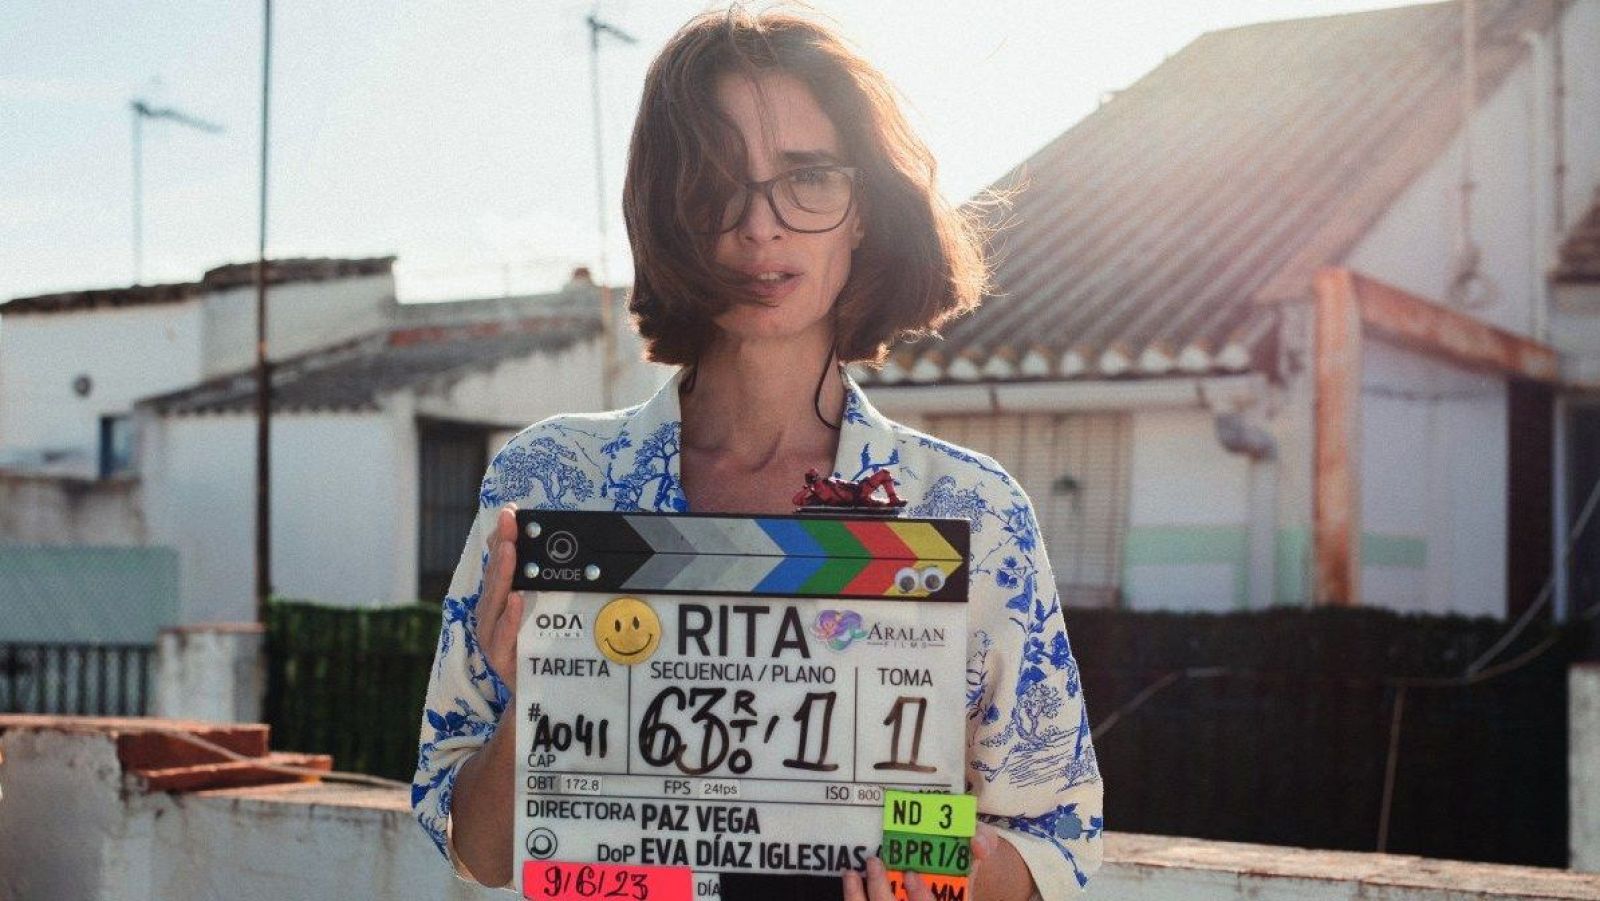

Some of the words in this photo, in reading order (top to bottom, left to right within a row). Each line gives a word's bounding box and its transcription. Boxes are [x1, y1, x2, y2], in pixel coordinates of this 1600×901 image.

[542, 568, 581, 581] OVIDE
[678, 604, 811, 658] RITA
[529, 657, 611, 678] TARJETA
[772, 665, 836, 684] PLANO
[878, 668, 933, 686] TOMA
[873, 696, 937, 773] 1
[527, 754, 556, 768] CAP
[527, 776, 556, 790] OBT
[566, 778, 599, 791] 172.8
[664, 780, 691, 795] FPS
[704, 783, 738, 795] 24fps
[826, 786, 849, 800] ISO
[858, 789, 881, 801] 800
[526, 800, 636, 821] DIRECTORA
[641, 804, 690, 831] PAZ
[696, 806, 761, 835] VEGA
[893, 800, 922, 826] ND
[939, 804, 953, 830] 3
[597, 844, 636, 863] DoP
[641, 837, 689, 866] EVA
[696, 834, 752, 868] DÍAZ
[760, 842, 867, 872] IGLESIAS
